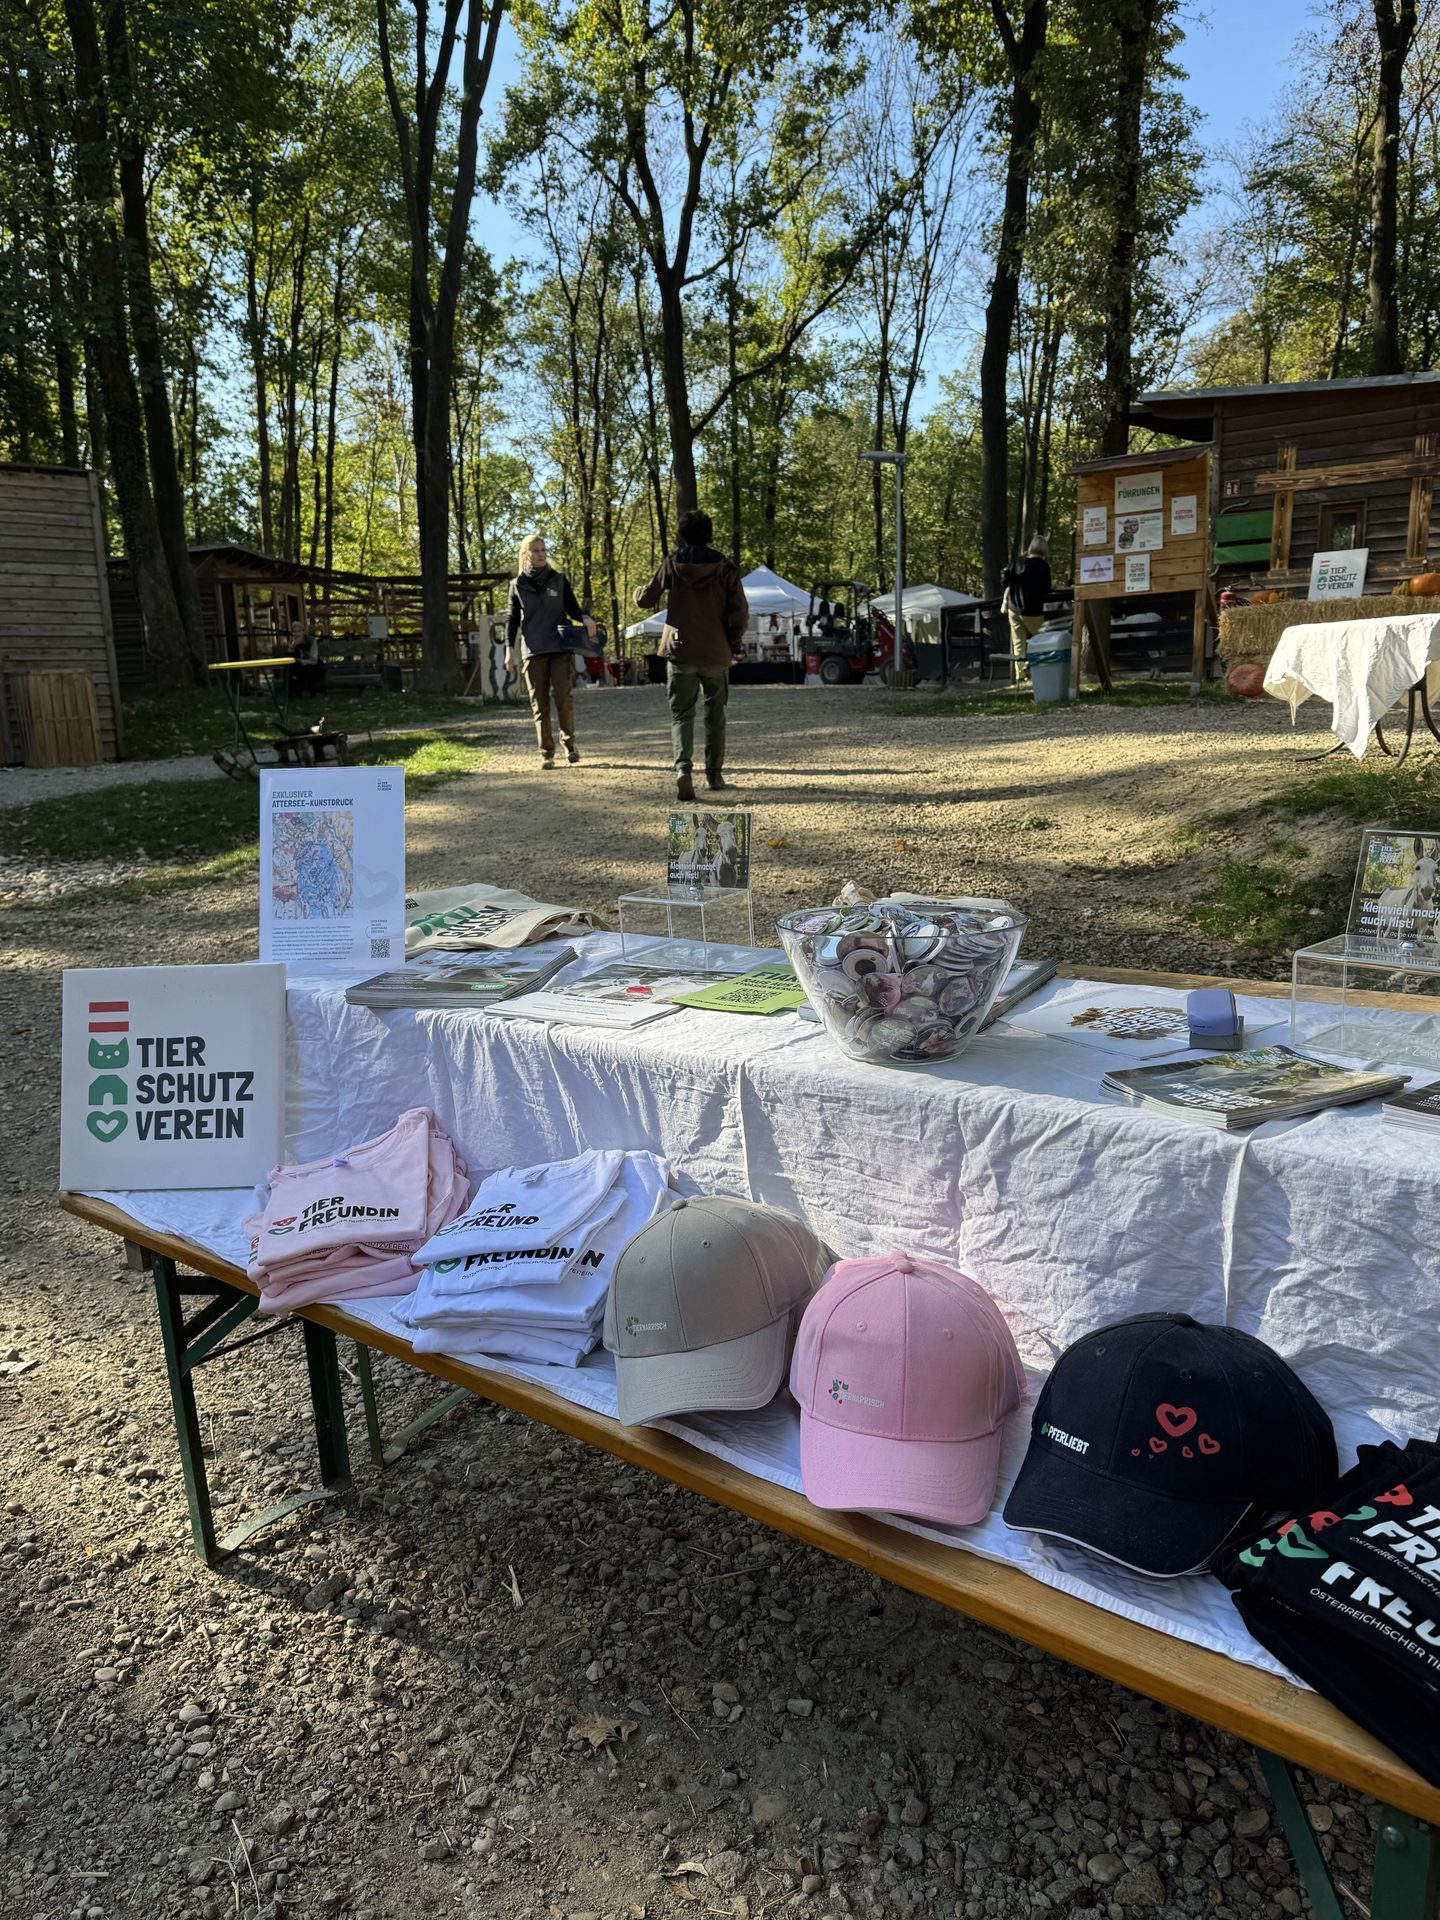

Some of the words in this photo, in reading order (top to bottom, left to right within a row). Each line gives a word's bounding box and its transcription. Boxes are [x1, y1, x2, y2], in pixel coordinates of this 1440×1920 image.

[1117, 486, 1160, 500] FÜHRUNGEN
[1329, 573, 1357, 582] SCHUTZ
[1330, 566, 1347, 575] TIER
[1328, 581, 1354, 590] VEREIN
[272, 790, 313, 799] EXKLUSIVER
[272, 798, 354, 808] ATTERSEE-KUNSTDRUCK
[1363, 901, 1409, 917] Kleinvieh
[437, 905, 508, 937] GUTEN
[1360, 914, 1386, 926] auch
[1388, 917, 1415, 929] Mist!
[436, 951, 513, 960] TIER
[1134, 1006, 1188, 1022] AUCH
[136, 1035, 206, 1068] TIER
[135, 1071, 255, 1104] SCHUTZ
[135, 1107, 245, 1141] VEREIN
[301, 1196, 345, 1219] TIER
[298, 1205, 400, 1232] FREUNDIN
[457, 1215, 540, 1230] FREUND
[1048, 1424, 1091, 1455] PFERLIEBT
[1309, 1587, 1426, 1658] ÖSTERREICHISCHER
